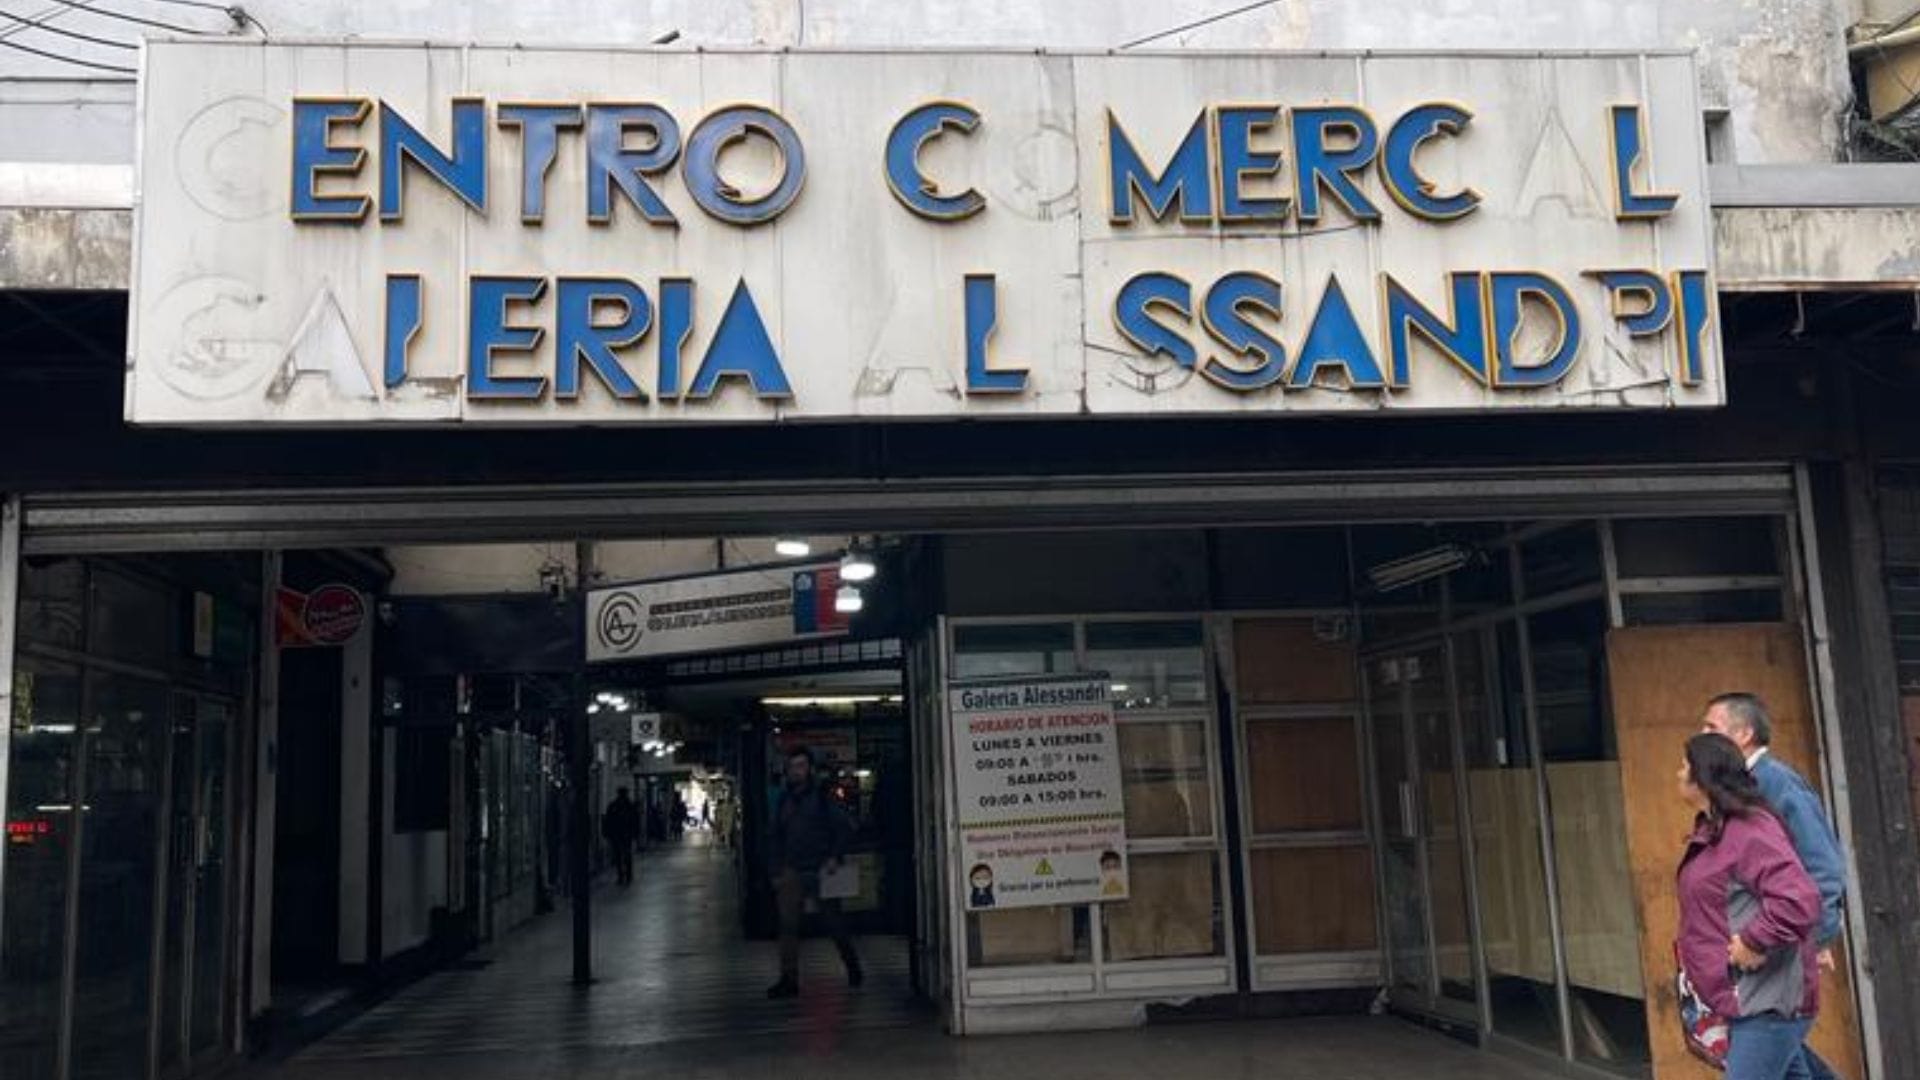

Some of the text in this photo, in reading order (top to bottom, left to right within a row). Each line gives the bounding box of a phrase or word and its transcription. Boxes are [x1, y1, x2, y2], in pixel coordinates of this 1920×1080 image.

[972, 733, 1103, 751] LUNES A VIERNES
[1020, 756, 1029, 767] A
[1023, 793, 1033, 804] A
